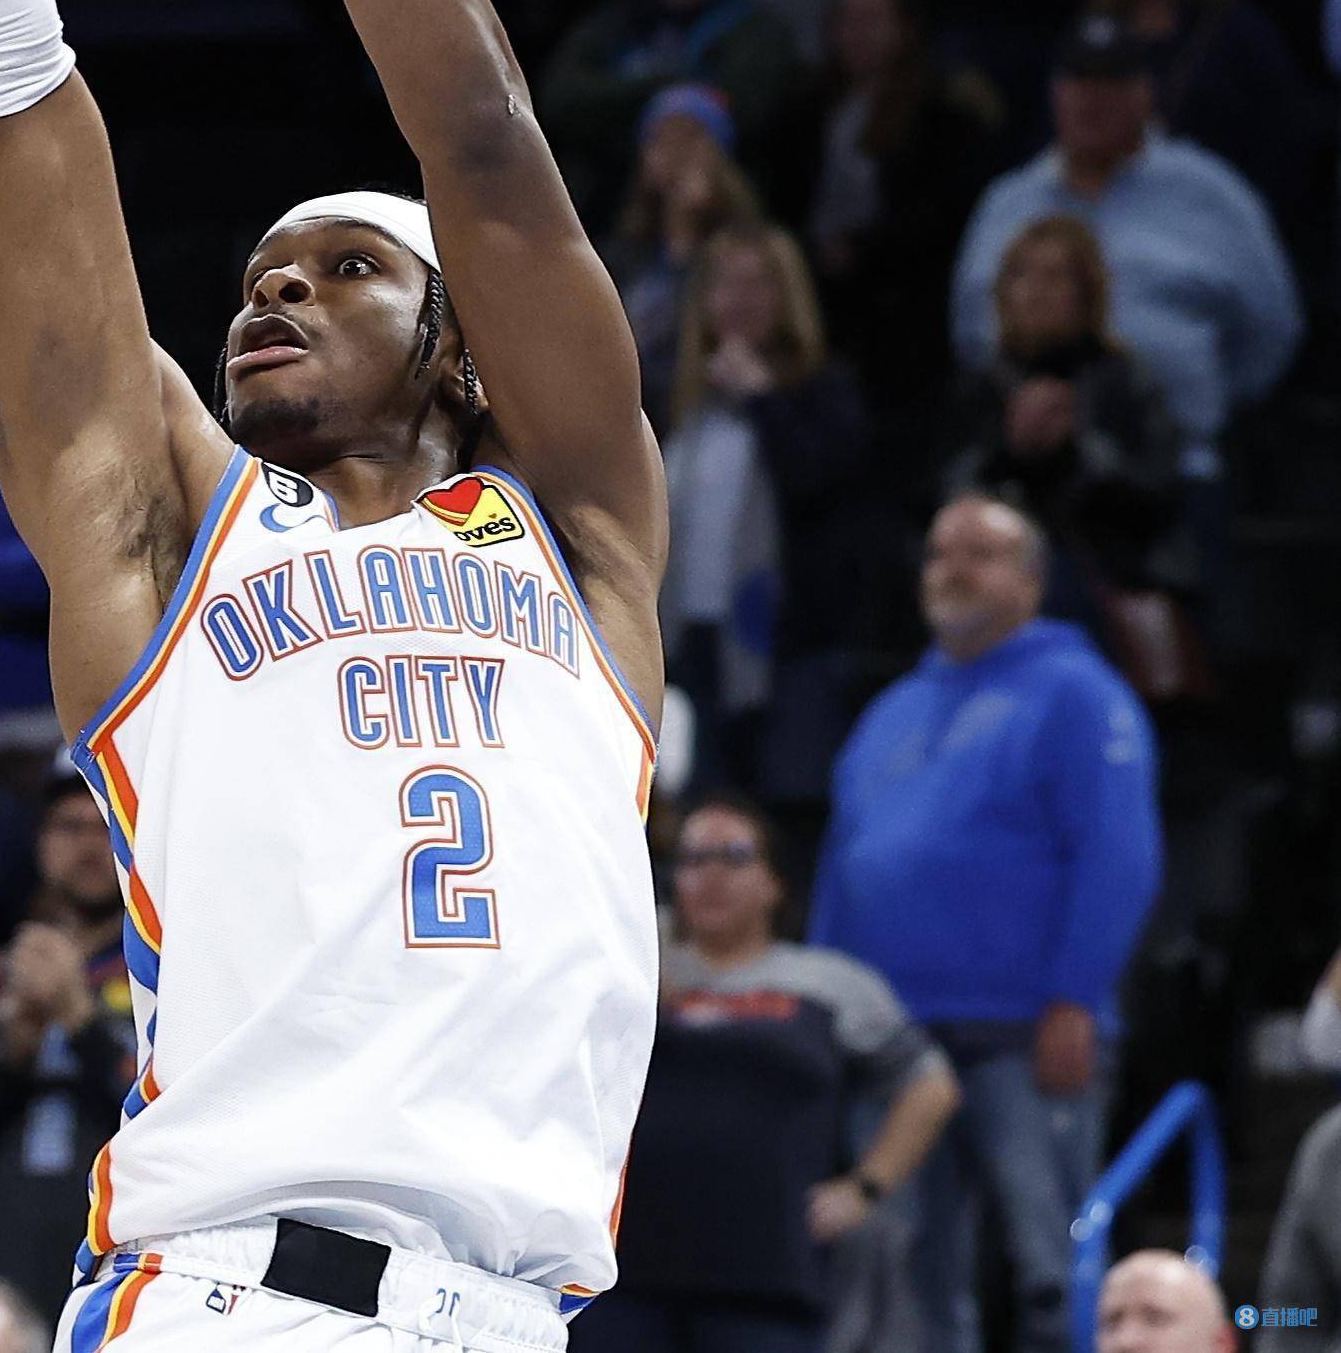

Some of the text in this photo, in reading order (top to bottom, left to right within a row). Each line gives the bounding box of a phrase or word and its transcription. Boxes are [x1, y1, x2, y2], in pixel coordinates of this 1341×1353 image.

[200, 544, 580, 681] OKLAHOMA
[337, 654, 505, 750] CITY
[399, 764, 501, 949] 2
